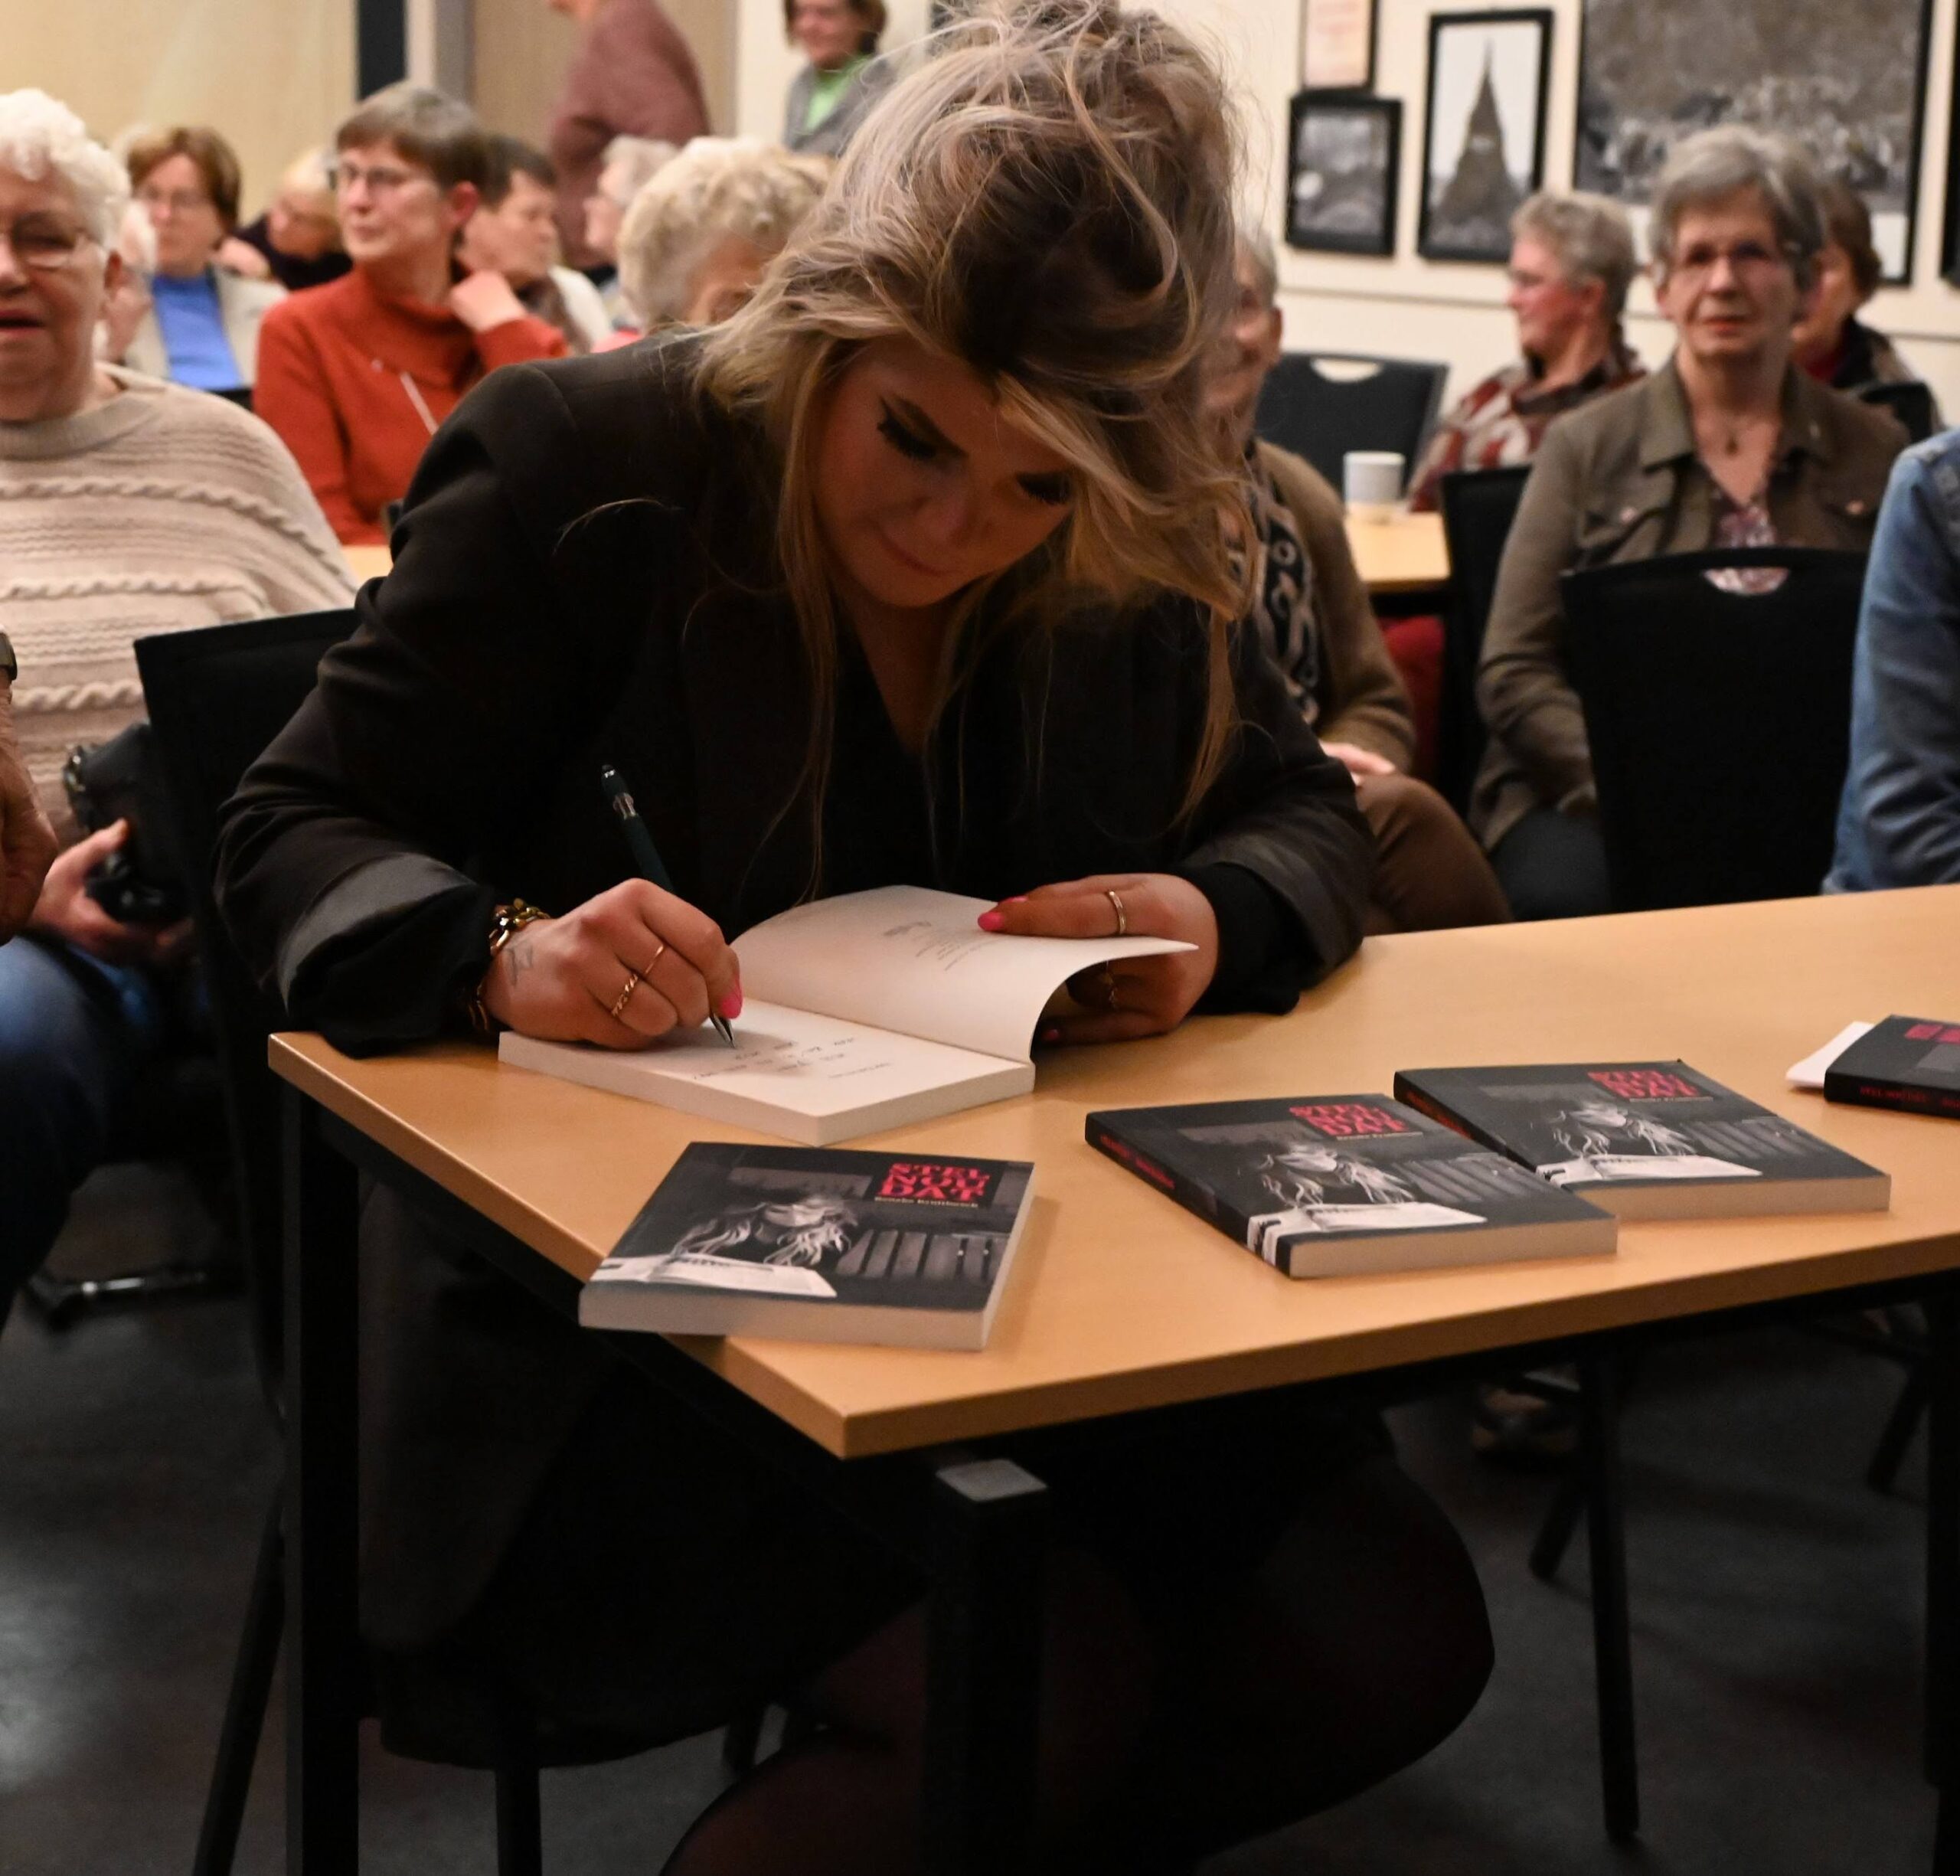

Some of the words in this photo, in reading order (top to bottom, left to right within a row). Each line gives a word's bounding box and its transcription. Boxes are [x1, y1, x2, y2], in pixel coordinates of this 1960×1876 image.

[889, 1162, 989, 1180] STEL
[885, 1172, 990, 1191] NOU
[877, 1183, 985, 1201] DAT
